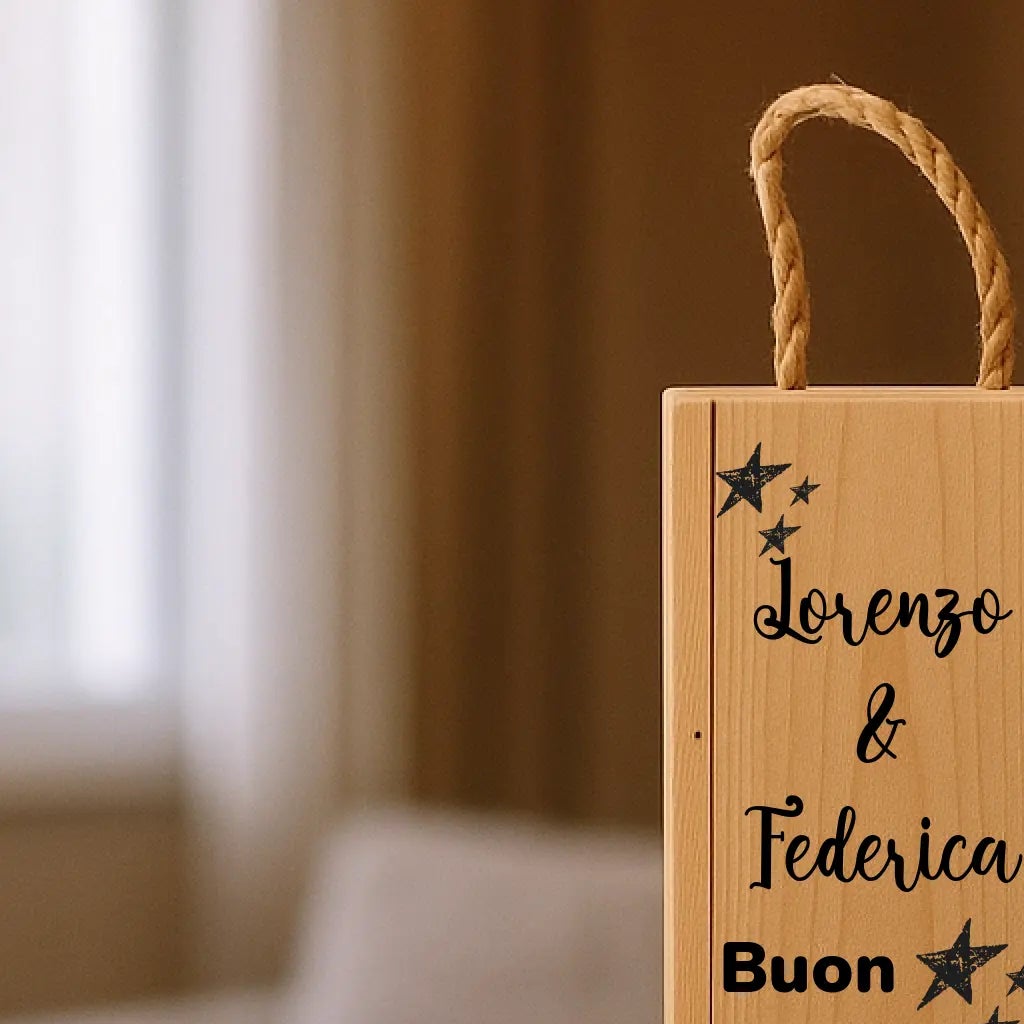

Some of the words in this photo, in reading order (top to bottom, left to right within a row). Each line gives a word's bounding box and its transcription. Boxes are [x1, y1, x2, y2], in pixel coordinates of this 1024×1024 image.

[753, 556, 1013, 659] Lorenzo
[856, 682, 907, 764] &
[744, 794, 1023, 893] Federica
[723, 941, 895, 994] Buon
